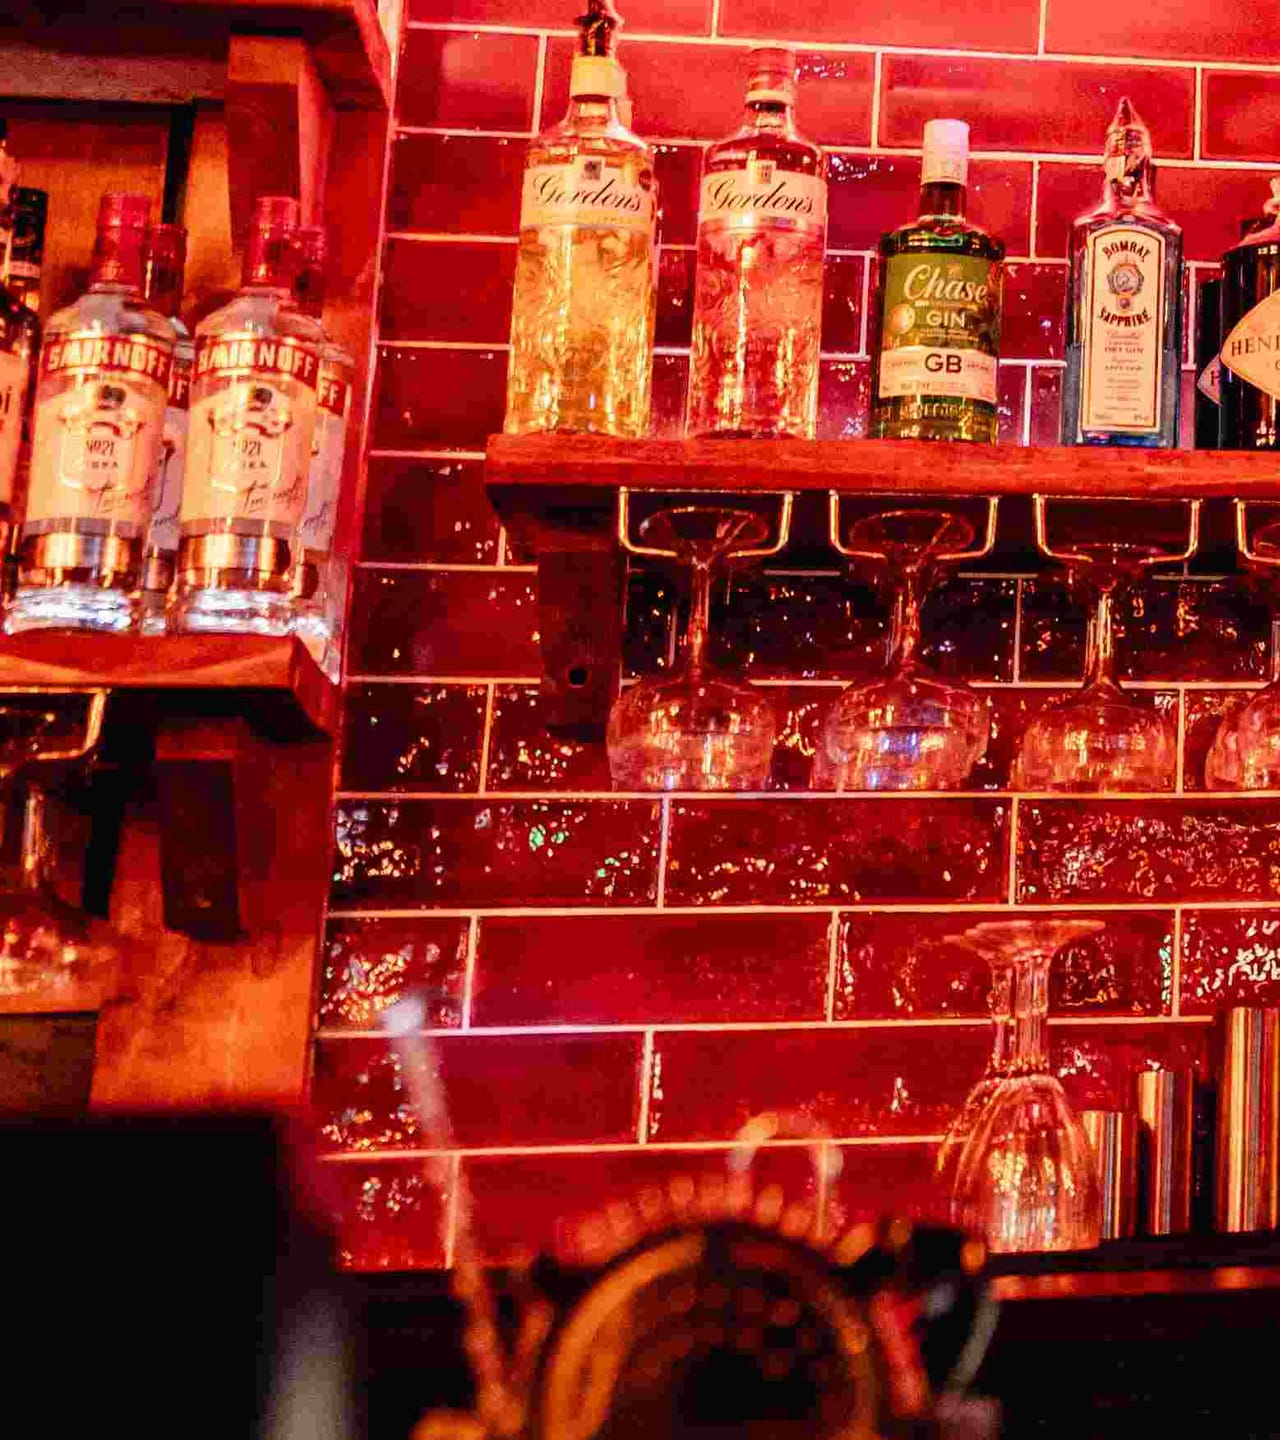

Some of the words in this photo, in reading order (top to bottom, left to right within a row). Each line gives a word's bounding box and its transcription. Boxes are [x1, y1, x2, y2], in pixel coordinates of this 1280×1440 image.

[533, 173, 643, 212] Gordon's
[711, 178, 815, 215] Gordon's
[1102, 240, 1151, 263] BOMBAY
[904, 264, 988, 304] Chase
[926, 311, 966, 328] GIN
[1098, 307, 1152, 327] SAPPHIRE
[47, 340, 168, 377] SMIRNOFF
[924, 353, 963, 374] GB
